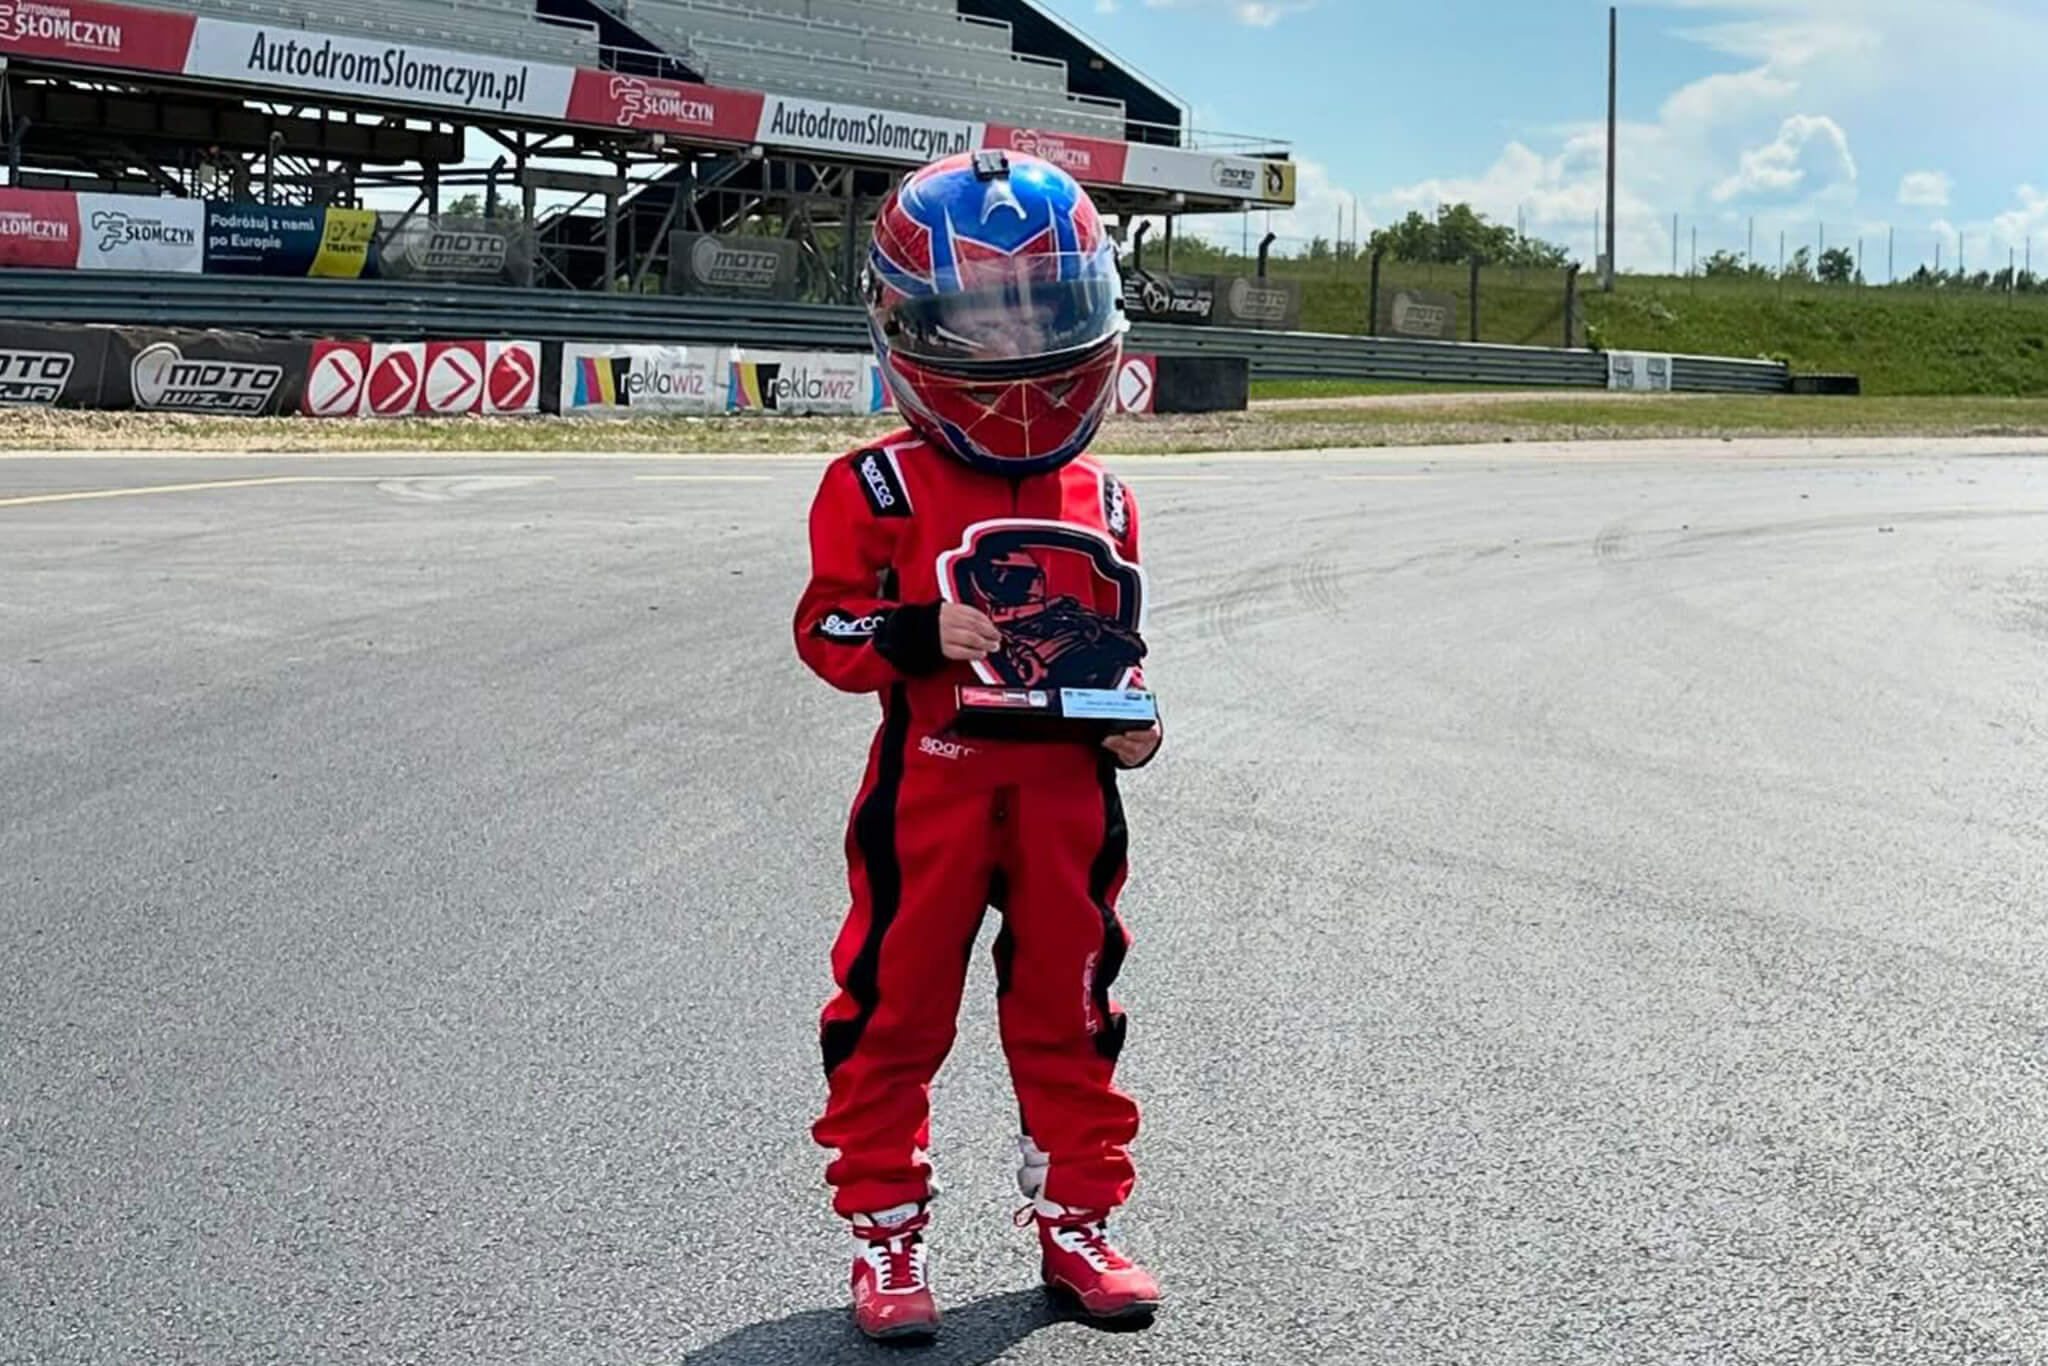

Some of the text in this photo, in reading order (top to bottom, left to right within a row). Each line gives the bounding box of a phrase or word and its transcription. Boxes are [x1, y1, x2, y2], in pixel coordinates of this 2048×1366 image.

[15, 14, 121, 47] SŁOMCZYN
[248, 31, 528, 109] AutodromSlomczyn.pl
[643, 96, 714, 121] SŁOMCZYN
[0, 220, 68, 237] ŁOMCZYN
[210, 214, 315, 232] Podróżuj z nami
[126, 225, 195, 243] SŁOMCZYN
[209, 233, 282, 249] po Europie
[430, 234, 504, 252] MOTO
[714, 252, 777, 269] MOTO
[1171, 298, 1211, 316] racing
[168, 364, 280, 389] MOTO
[620, 360, 705, 395] reklawiz
[767, 366, 855, 399] reklawiz
[161, 389, 263, 409] WIZJA
[861, 455, 895, 509] sparco
